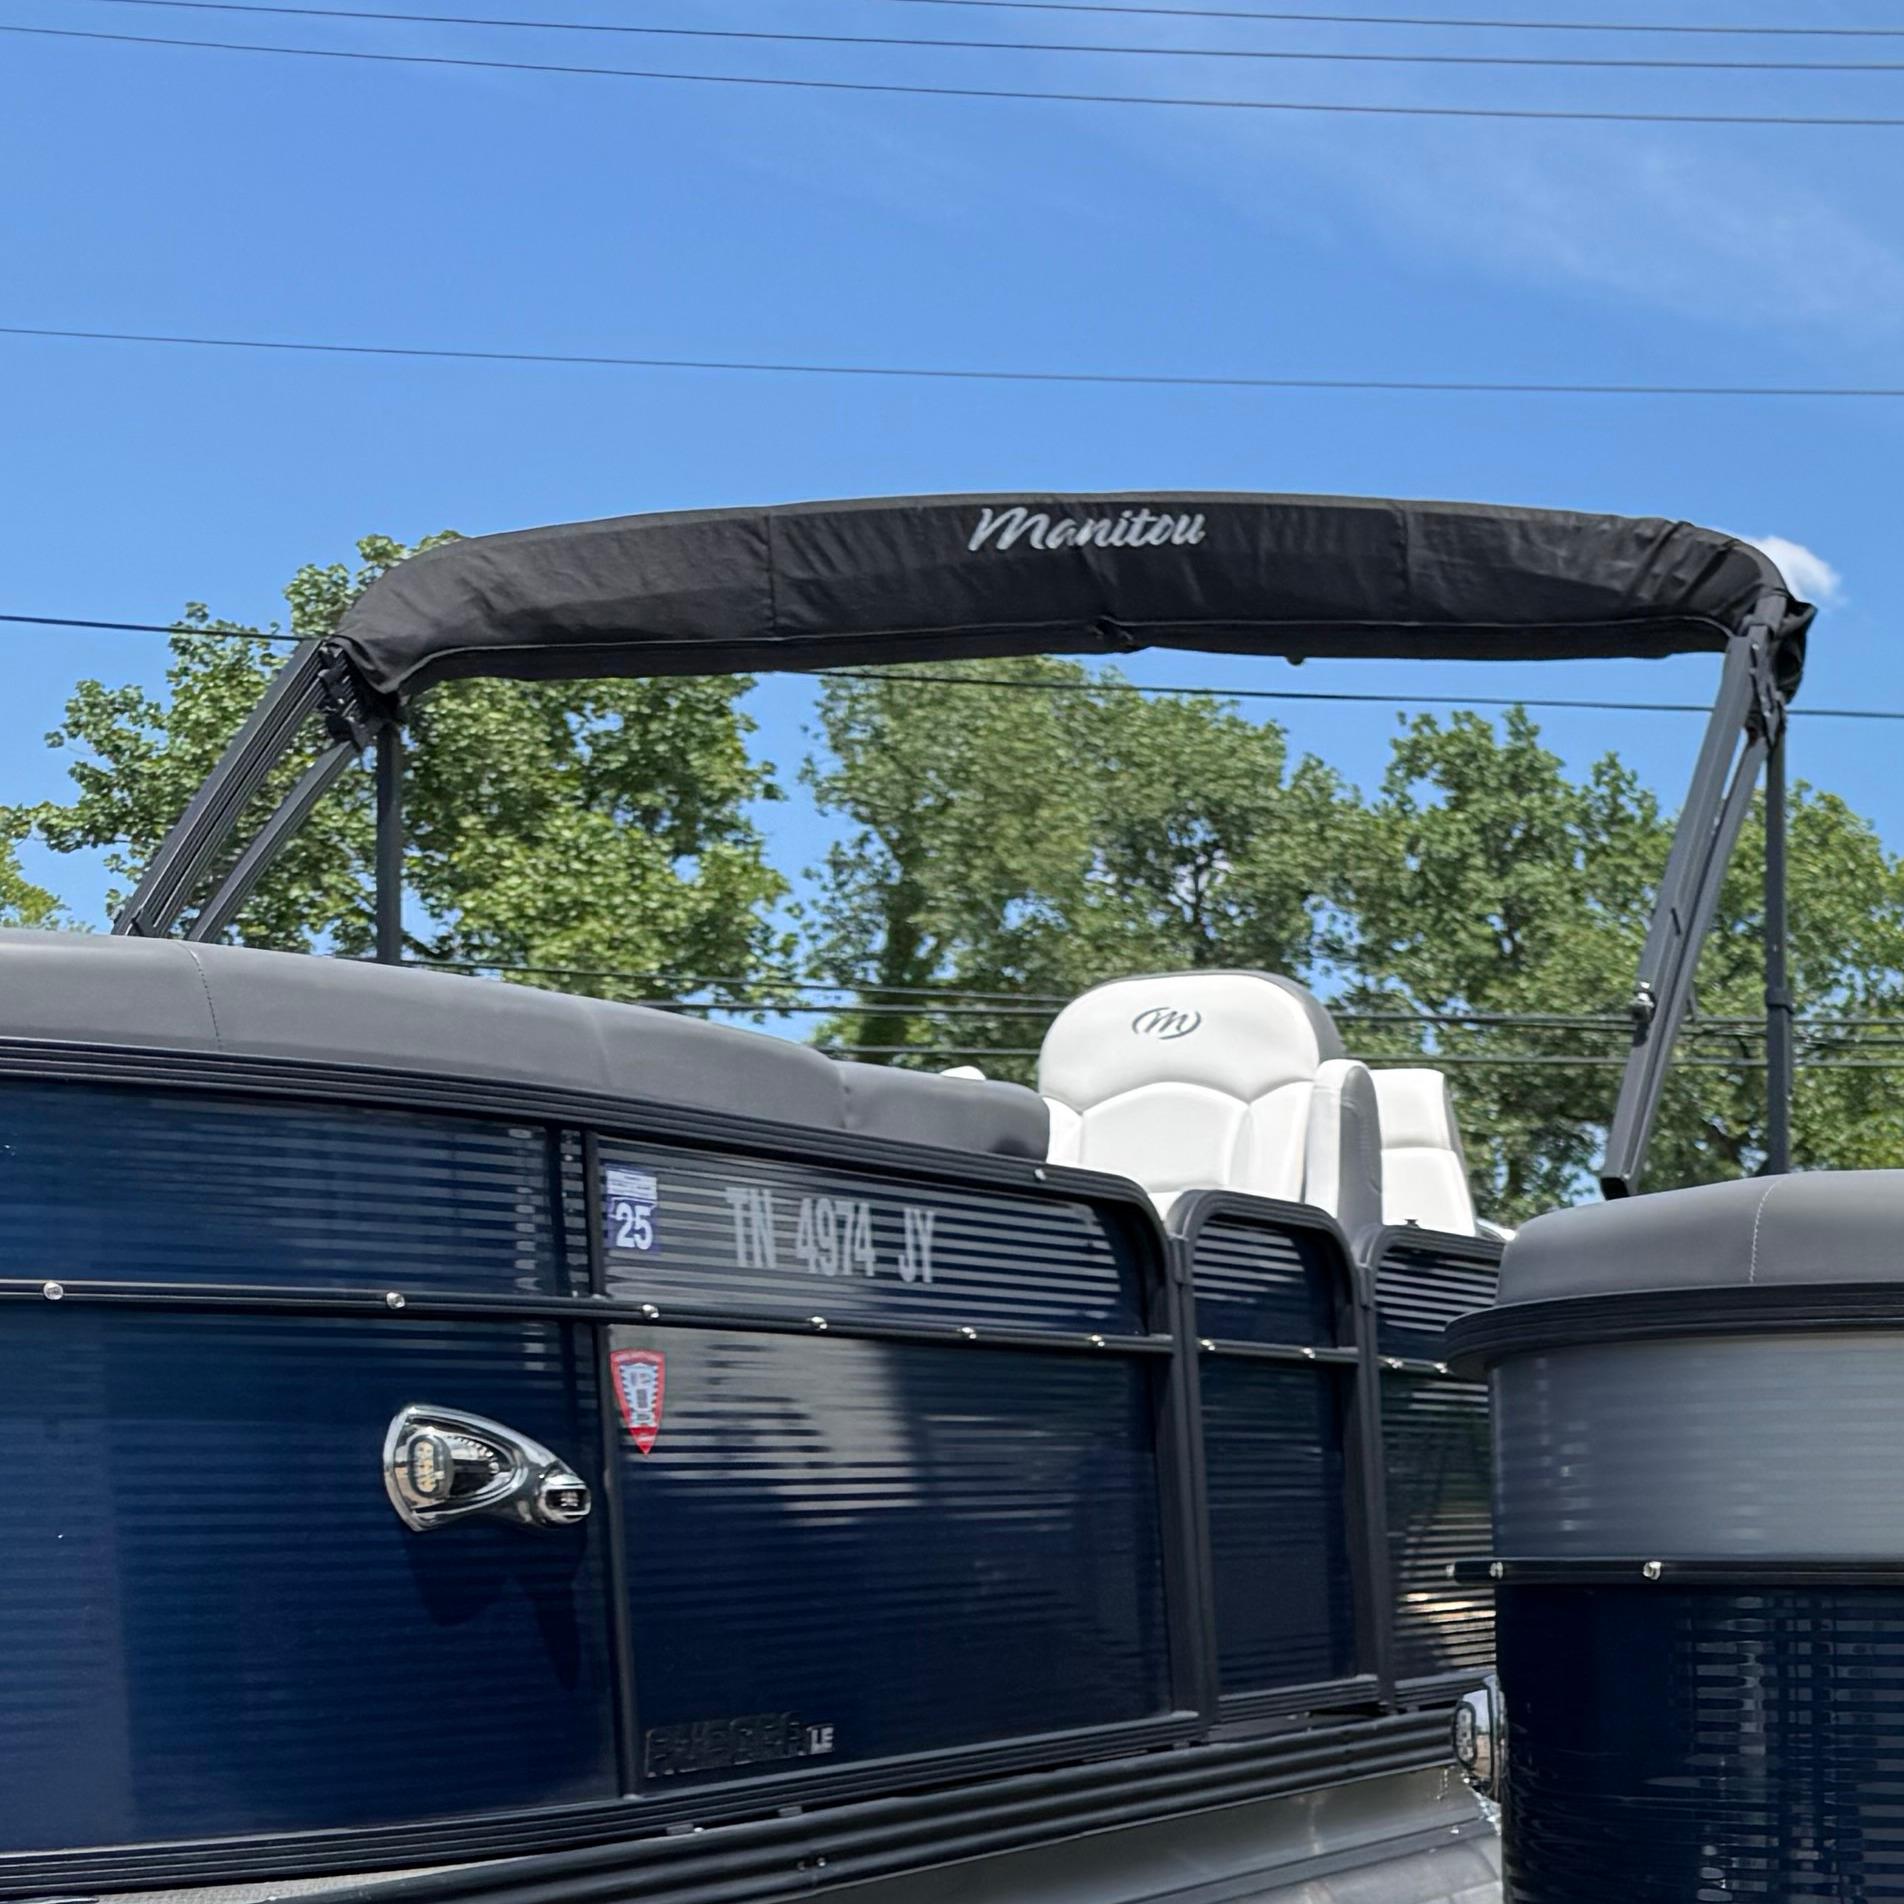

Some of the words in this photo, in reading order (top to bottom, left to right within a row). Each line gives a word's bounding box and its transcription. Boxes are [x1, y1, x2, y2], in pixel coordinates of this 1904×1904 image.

[968, 506, 1205, 551] Manitou
[616, 1202, 655, 1250] 25
[726, 1187, 776, 1269] TN
[796, 1198, 876, 1277] 4974
[898, 1208, 937, 1283] JY
